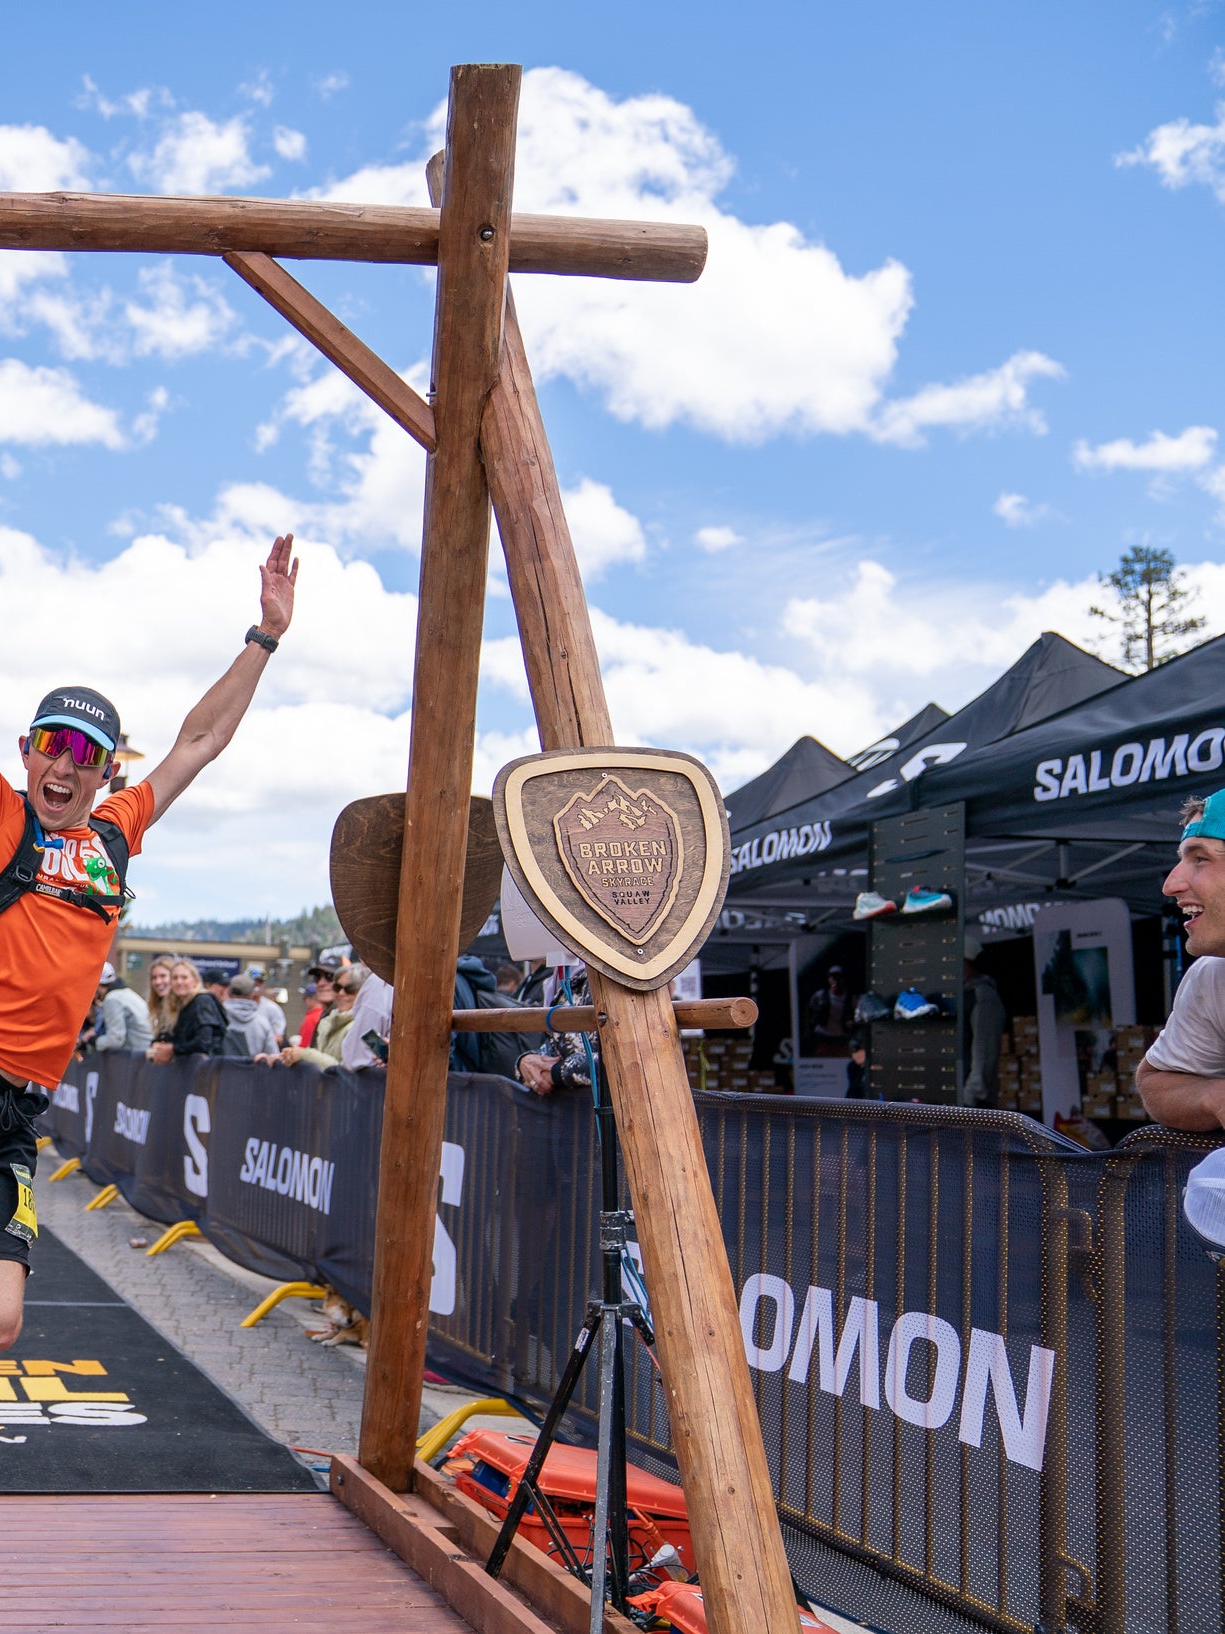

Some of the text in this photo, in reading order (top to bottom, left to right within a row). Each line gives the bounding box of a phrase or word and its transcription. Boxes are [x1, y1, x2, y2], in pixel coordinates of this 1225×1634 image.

[63, 698, 105, 720] nuun
[1034, 728, 1225, 802] SALOMO
[579, 840, 667, 858] BROKEN
[588, 858, 662, 875] ARROW
[602, 876, 654, 887] SKYRACE
[612, 890, 650, 898] SQUAW
[240, 1137, 335, 1215] SALOMON
